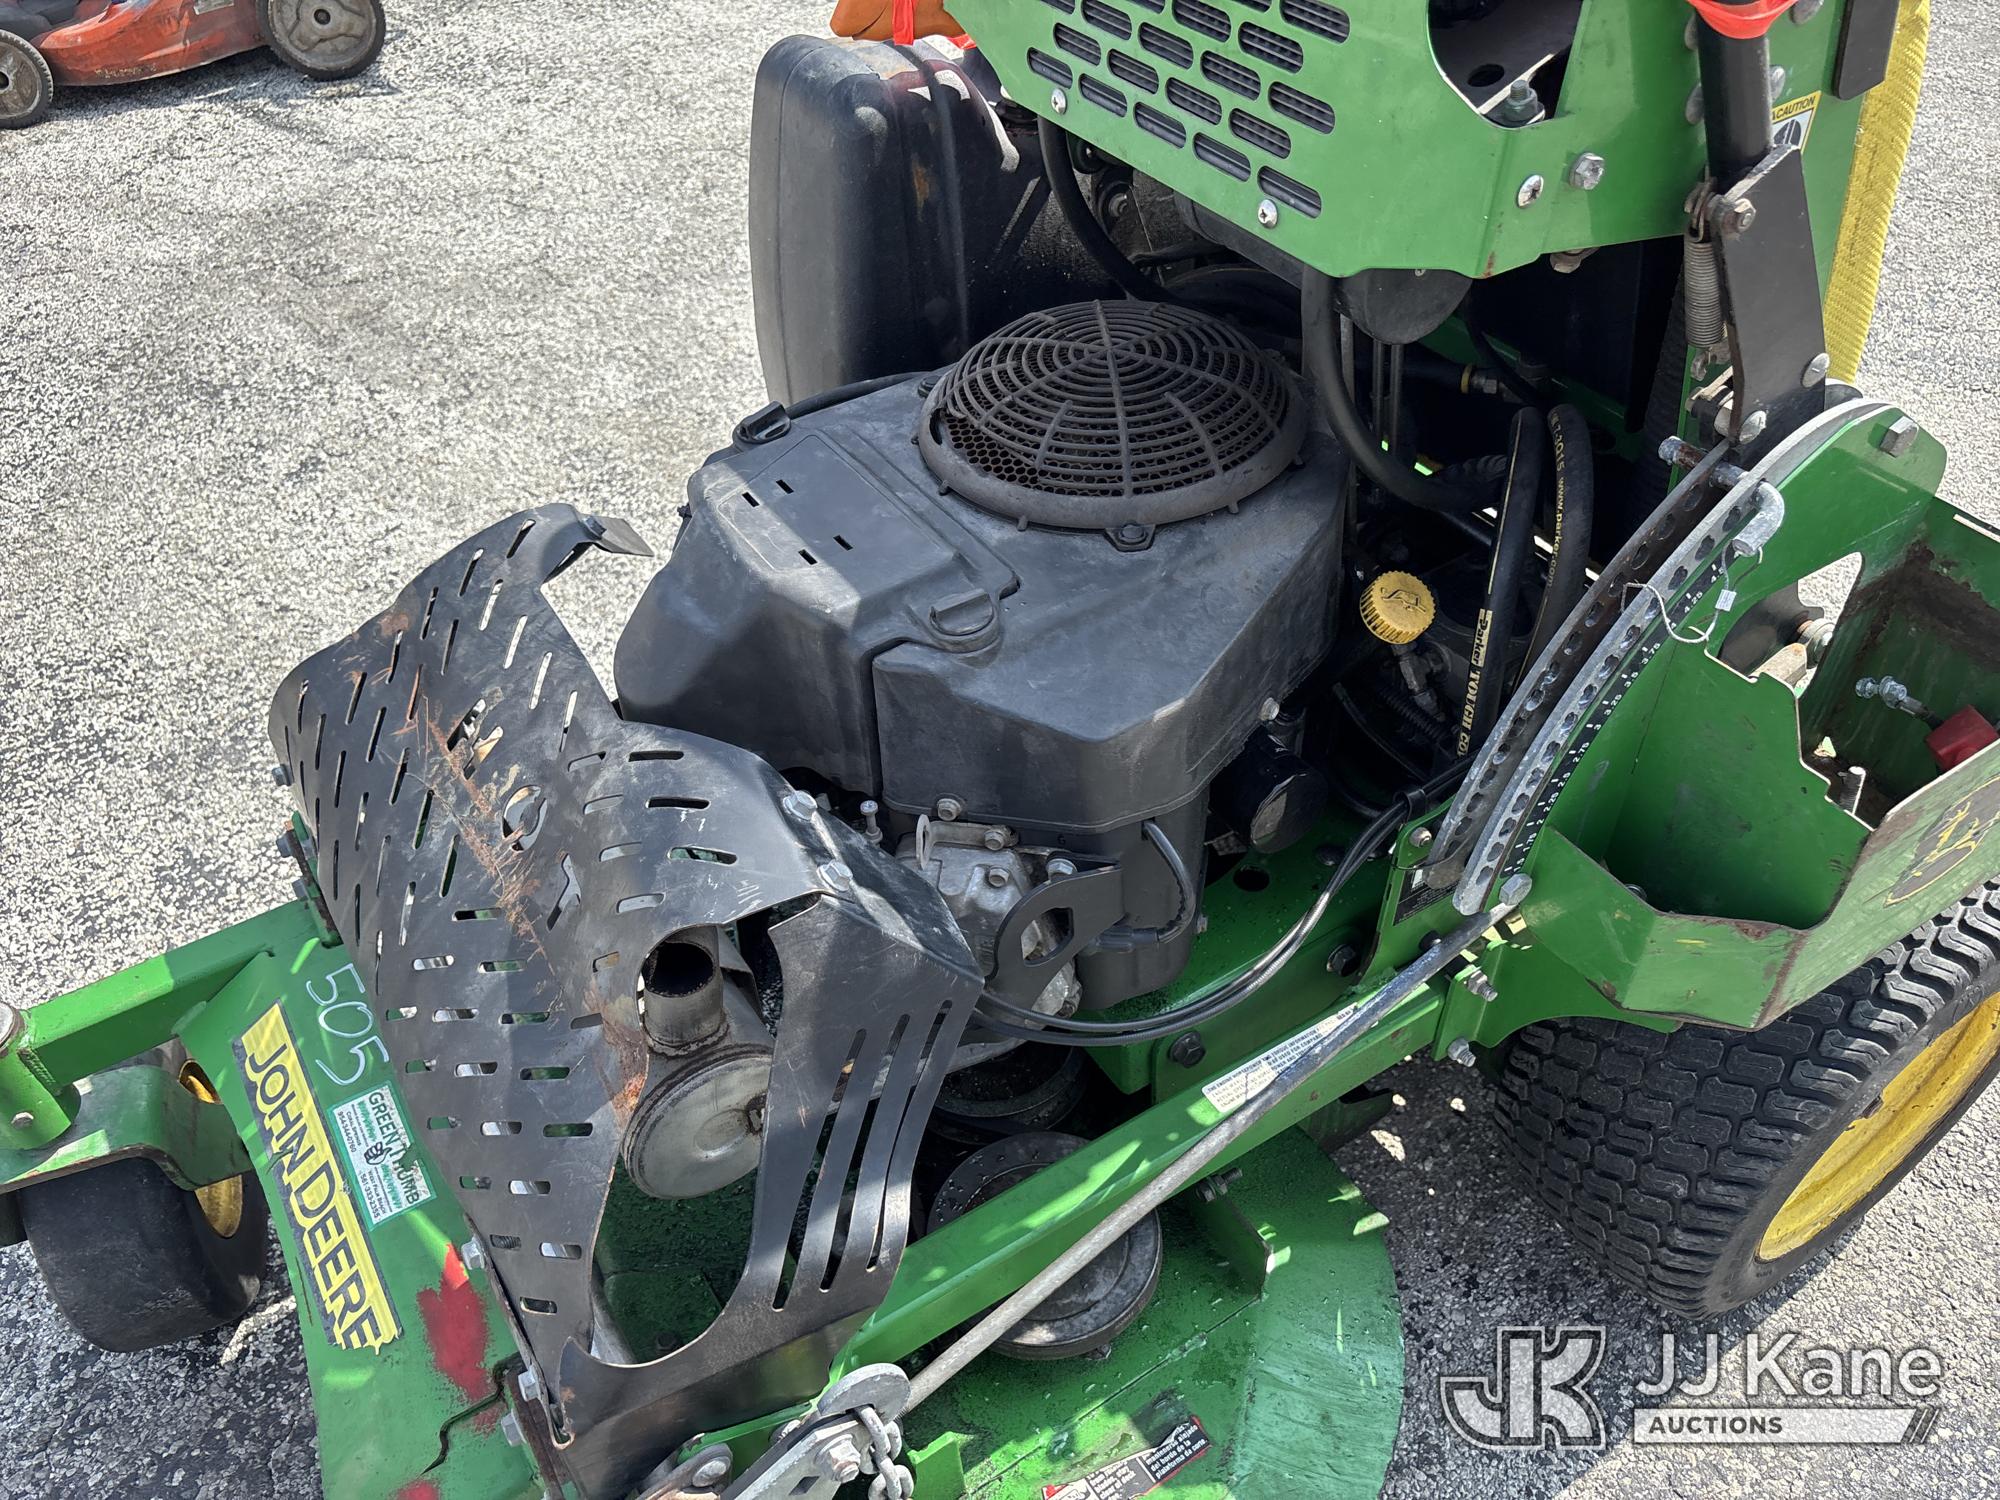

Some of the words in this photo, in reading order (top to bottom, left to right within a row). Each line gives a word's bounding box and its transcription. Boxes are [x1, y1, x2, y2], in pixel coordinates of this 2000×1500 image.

[1776, 95, 1816, 119] CAUTION
[1547, 477, 1565, 587] www.parker.com
[1471, 613, 1492, 667] Parker
[1462, 669, 1481, 731] TOUGH
[306, 962, 390, 1086] 505
[367, 1090, 400, 1145] GREEN
[249, 1043, 317, 1180] JOHN
[294, 1160, 381, 1349] DEERE
[1149, 1460, 1161, 1472] del
[1159, 1449, 1177, 1464] borde
[1175, 1443, 1185, 1452] de
[1183, 1439, 1191, 1447] la
[1177, 1423, 1198, 1442] alejado
